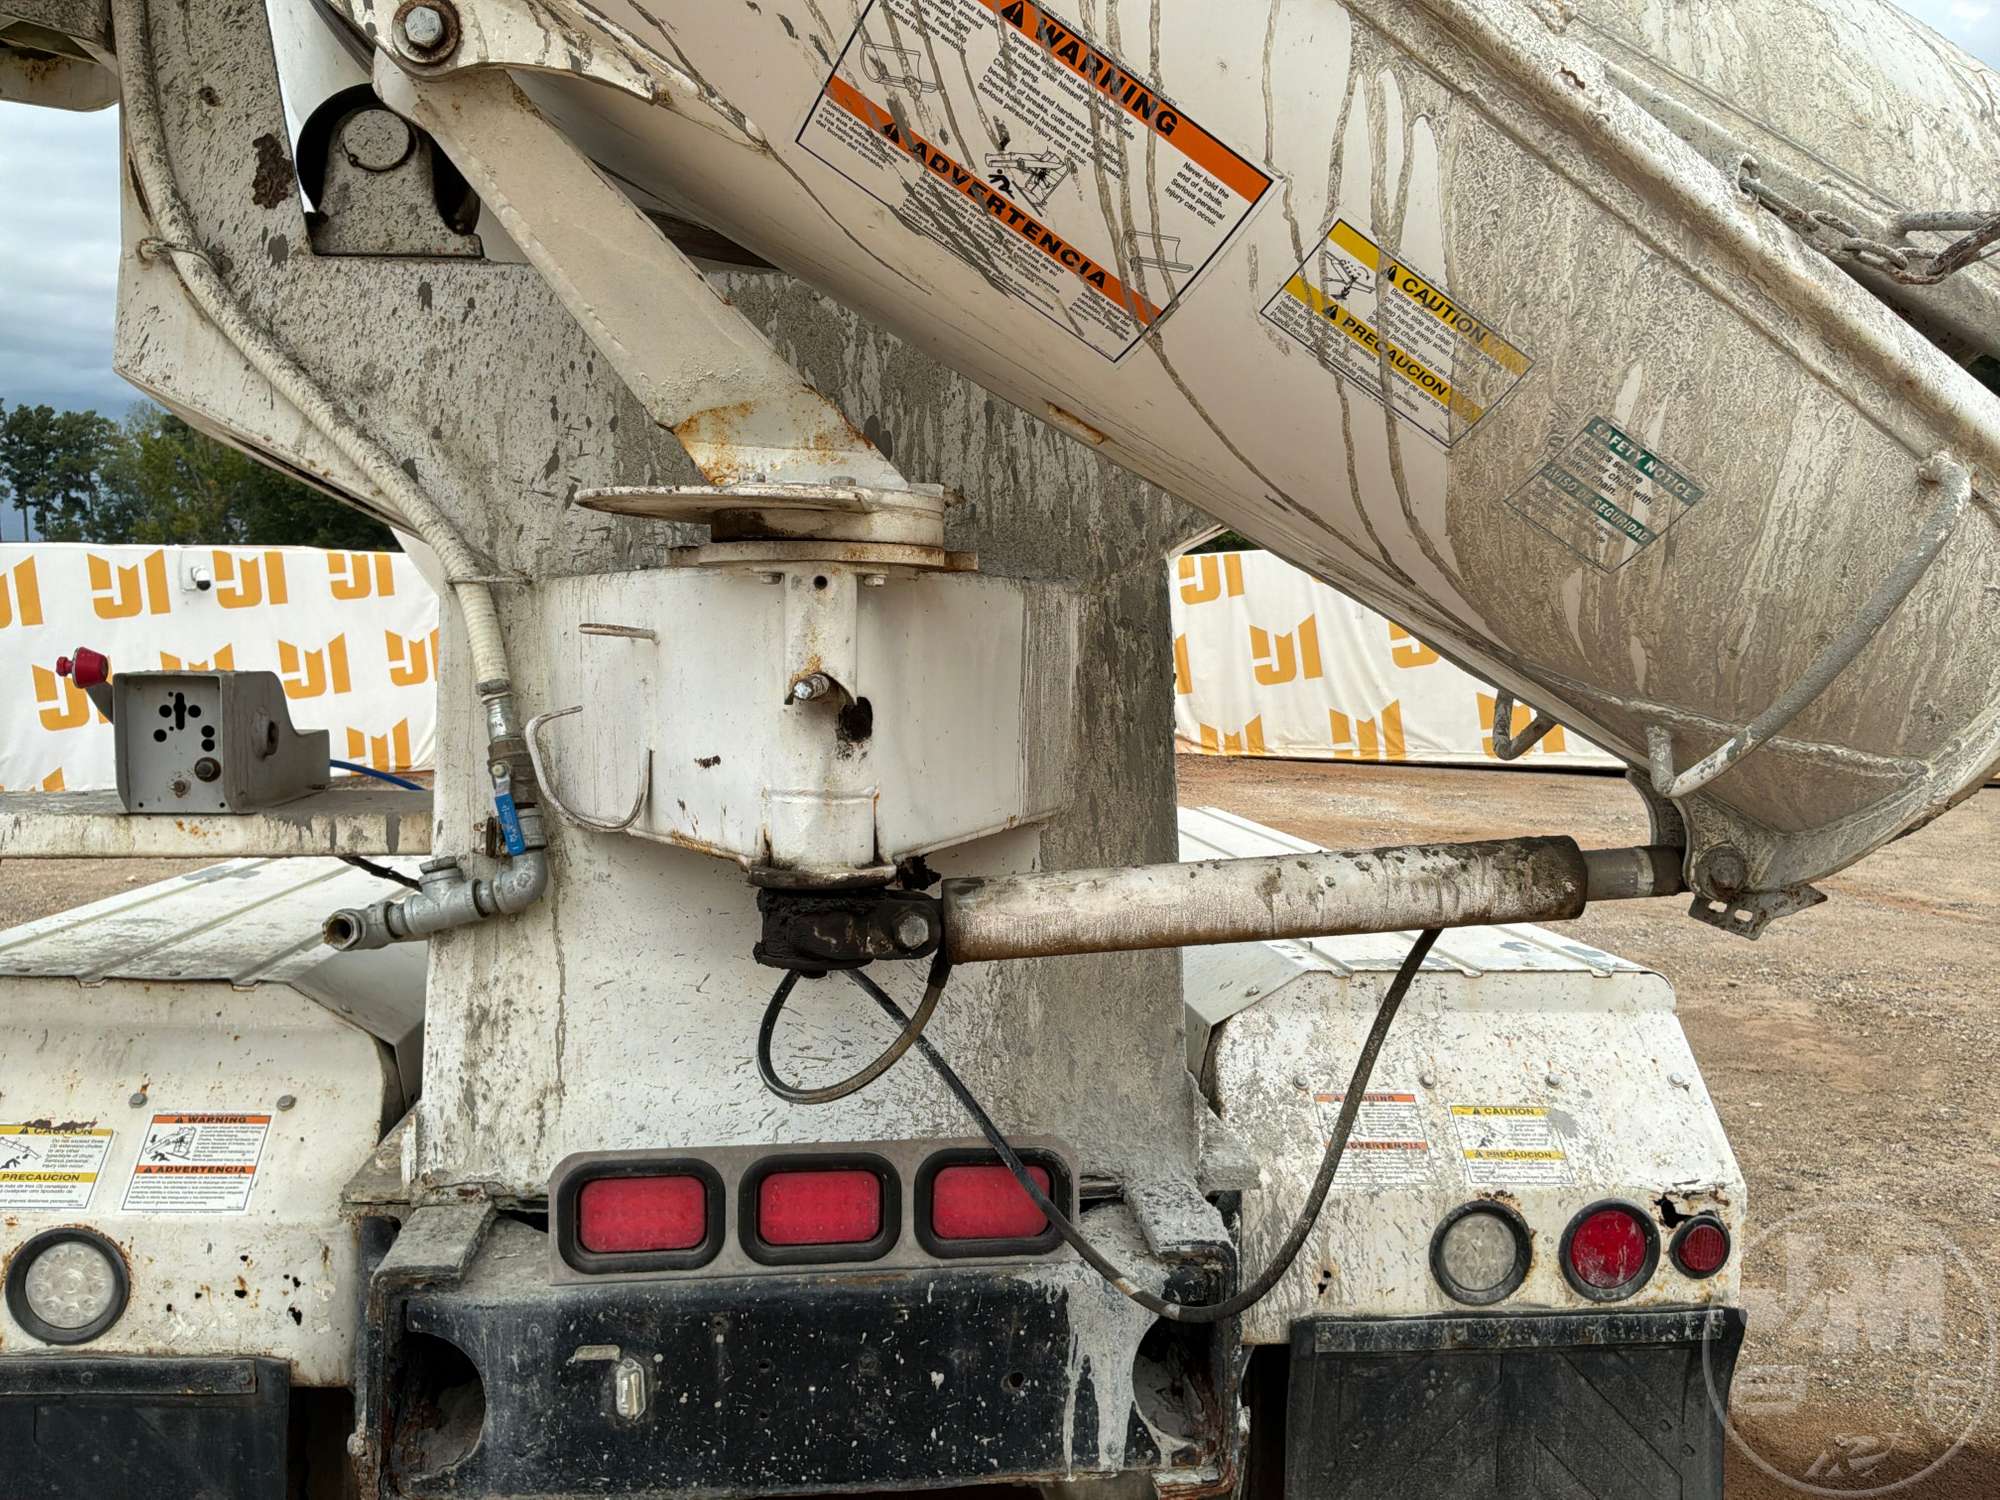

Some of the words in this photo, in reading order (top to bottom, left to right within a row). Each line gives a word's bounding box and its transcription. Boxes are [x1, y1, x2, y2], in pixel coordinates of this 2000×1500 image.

[895, 1, 903, 9] so
[904, 8, 918, 20] can
[956, 9, 983, 29] around
[959, 0, 975, 12] your
[934, 16, 958, 37] Failure
[959, 34, 966, 43] to
[993, 57, 1017, 81] Chutes,
[1020, 77, 1040, 96] hoses
[1041, 94, 1055, 106] and
[1055, 103, 1086, 129] hardware
[1001, 41, 1017, 53] pull
[1017, 52, 1041, 71] chutes
[1041, 69, 1056, 83] over
[1057, 80, 1083, 102] himself
[1083, 99, 1104, 119] during
[1106, 117, 1134, 140] concrete
[1009, 31, 1039, 57] Operator
[1040, 56, 1064, 75] should
[1064, 74, 1076, 84] not
[1076, 83, 1097, 99] stand
[1096, 96, 1125, 119] beneath
[1038, 18, 1178, 136] WARNING
[822, 107, 834, 117] con
[835, 117, 847, 127] sus
[848, 125, 868, 142] dedos
[977, 82, 1003, 104] Serious
[1003, 103, 1034, 126] personal
[1034, 123, 1052, 142] injury
[1053, 139, 1066, 150] can
[1066, 149, 1086, 166] occur.
[982, 74, 1005, 93] Check
[1004, 90, 1025, 109] hoses
[1026, 107, 1040, 119] and
[1040, 116, 1070, 142] hardware
[1070, 140, 1080, 149] on
[987, 65, 1016, 90] because
[1016, 88, 1025, 96] of
[1025, 93, 1048, 116] breaks,
[1050, 113, 1065, 126] cuts
[1065, 124, 1073, 132] or
[1074, 131, 1090, 144] wear
[815, 118, 826, 128] del
[827, 126, 845, 142] borde
[846, 140, 857, 150] del
[824, 116, 834, 126] los
[835, 124, 853, 139] lados
[854, 139, 886, 163] exteriores
[825, 99, 852, 122] Siempre
[887, 145, 909, 163] manos
[1170, 178, 1196, 199] Serious
[1194, 197, 1225, 220] personal
[1176, 171, 1191, 183] end
[1202, 190, 1222, 207] chute.
[1182, 161, 1202, 179] Never
[1202, 176, 1219, 190] hold
[1217, 187, 1229, 199] the
[914, 142, 1106, 288] ADVERTENCIA
[930, 176, 959, 198] operador
[960, 197, 968, 205] no
[1023, 241, 1032, 250] de
[1031, 249, 1043, 257] pie
[1043, 255, 1064, 273] debajo
[1164, 185, 1184, 204] injury
[1184, 201, 1196, 212] can
[1196, 210, 1215, 227] occur.
[1017, 246, 1039, 263] encima
[1039, 261, 1048, 270] de
[1048, 268, 1057, 276] su
[1274, 305, 1294, 321] Retire
[1292, 319, 1304, 328] las
[1279, 300, 1297, 314] nadie
[1297, 313, 1306, 321] en
[1383, 295, 1394, 304] on
[1393, 302, 1410, 316] other
[1410, 315, 1424, 326] side
[1423, 325, 1435, 334] are
[1389, 288, 1412, 306] Before
[1411, 304, 1440, 328] unfolding
[1403, 279, 1487, 344] CAUTION
[1284, 293, 1303, 309] Antes
[1408, 383, 1417, 392] de
[1416, 391, 1430, 401] que
[1429, 399, 1439, 407] no
[1388, 334, 1418, 355] personal
[1433, 365, 1446, 376] can
[1394, 314, 1415, 331] hands
[1414, 330, 1432, 345] away
[1431, 342, 1449, 356] when
[1342, 318, 1447, 396] PRECAUCION
[1592, 424, 1645, 462] SAFETY
[1644, 461, 1694, 499] NOTICE
[1611, 461, 1643, 484] secure
[1544, 465, 1578, 491] AVISO
[1593, 500, 1650, 541] SEGURIDAD
[1589, 475, 1616, 496] chain.
[1607, 473, 1633, 492] chute
[1631, 490, 1653, 505] with
[1484, 1107, 1534, 1115] CAUTION
[2, 1173, 80, 1181] PRECAUCION
